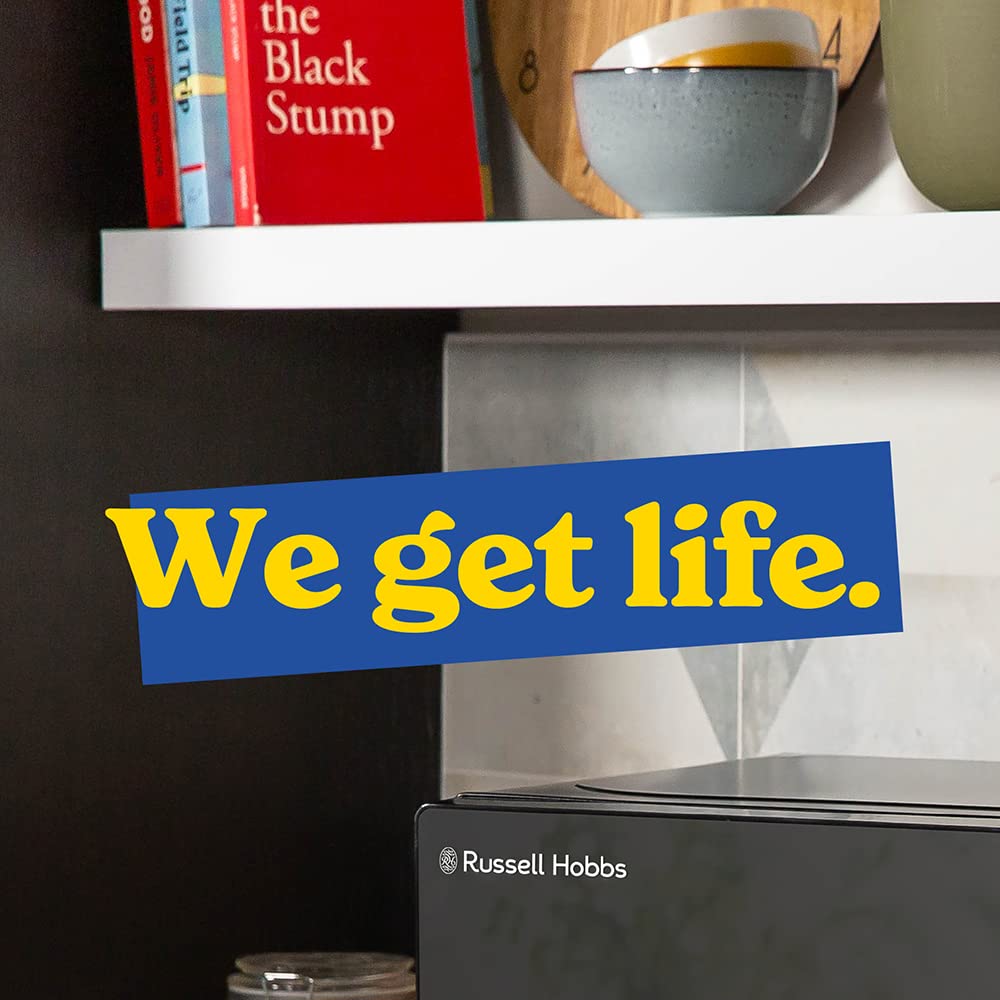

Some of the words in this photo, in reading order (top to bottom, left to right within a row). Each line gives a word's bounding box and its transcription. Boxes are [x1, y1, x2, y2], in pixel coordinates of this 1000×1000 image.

[173, 0, 189, 52] ield
[260, 0, 320, 35] the
[823, 17, 843, 63] 4
[262, 38, 371, 86] Black
[518, 50, 540, 94] 8
[177, 60, 192, 113] Trip
[266, 88, 395, 150] Stump
[463, 850, 545, 876] Russell
[552, 853, 628, 879] Hobbs
